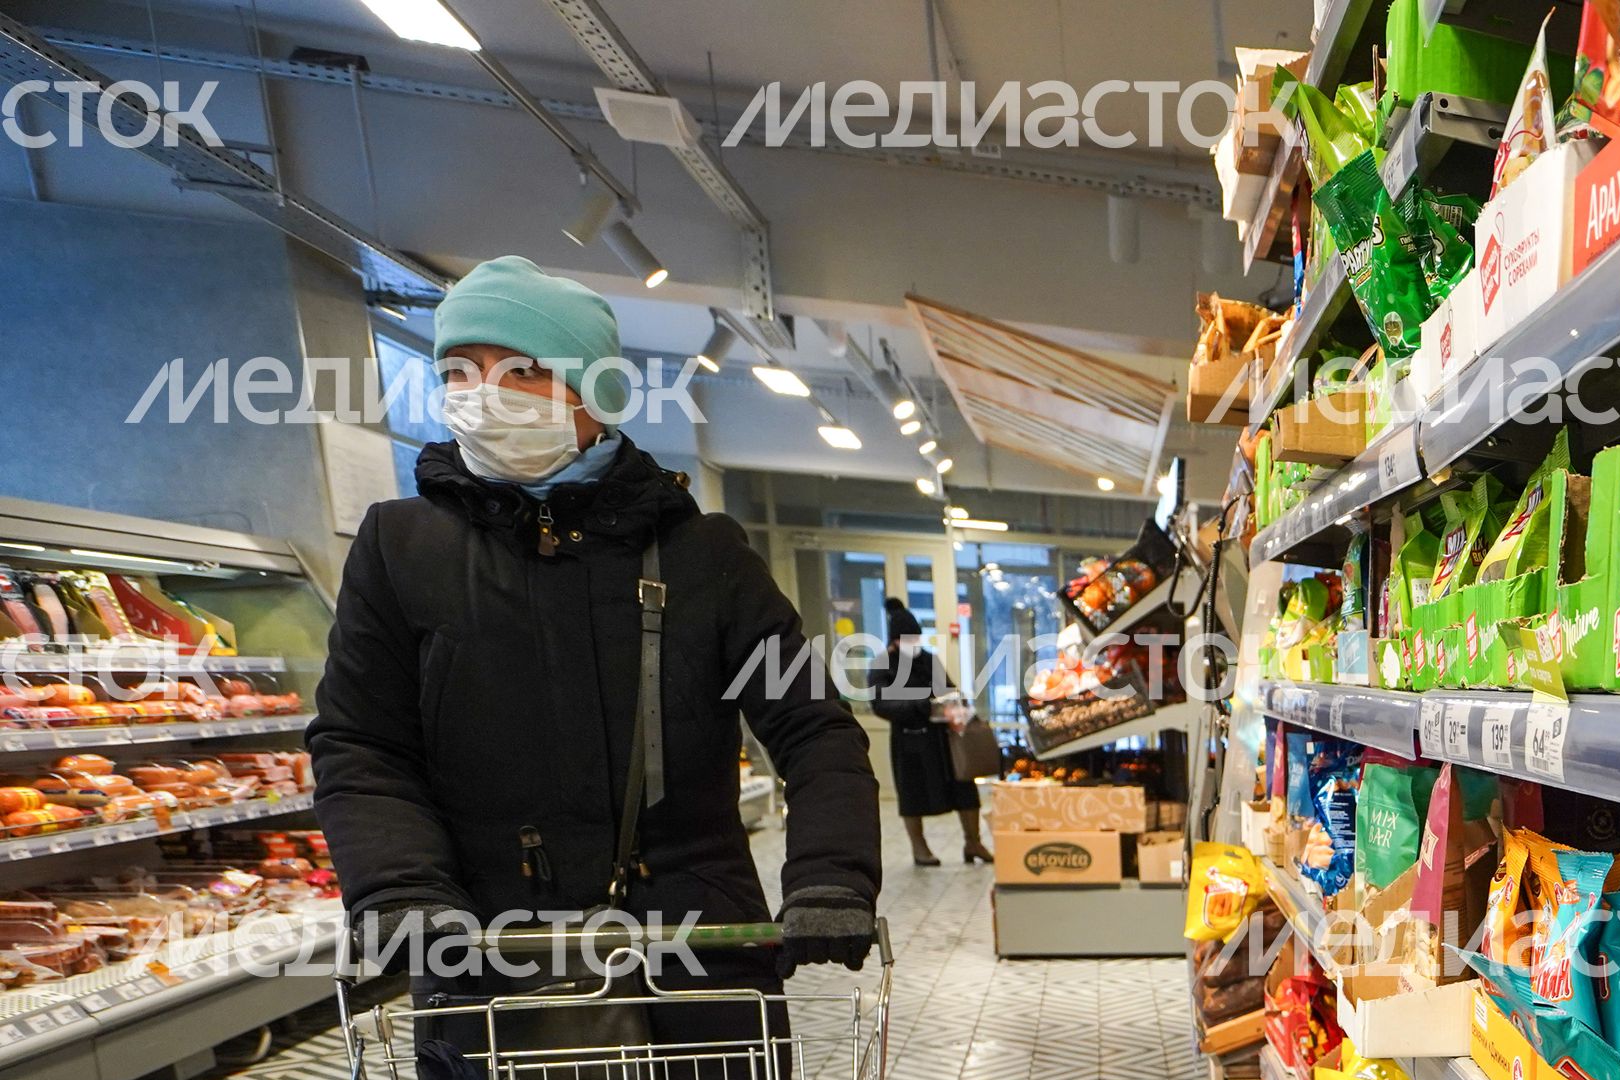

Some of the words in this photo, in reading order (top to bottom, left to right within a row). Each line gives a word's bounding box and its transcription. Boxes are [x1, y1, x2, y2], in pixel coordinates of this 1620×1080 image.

[1562, 606, 1599, 659] Nature
[1491, 723, 1504, 751] 139
[1532, 727, 1545, 759] 64
[1368, 829, 1393, 849] BAR
[1026, 851, 1090, 869] ekovita
